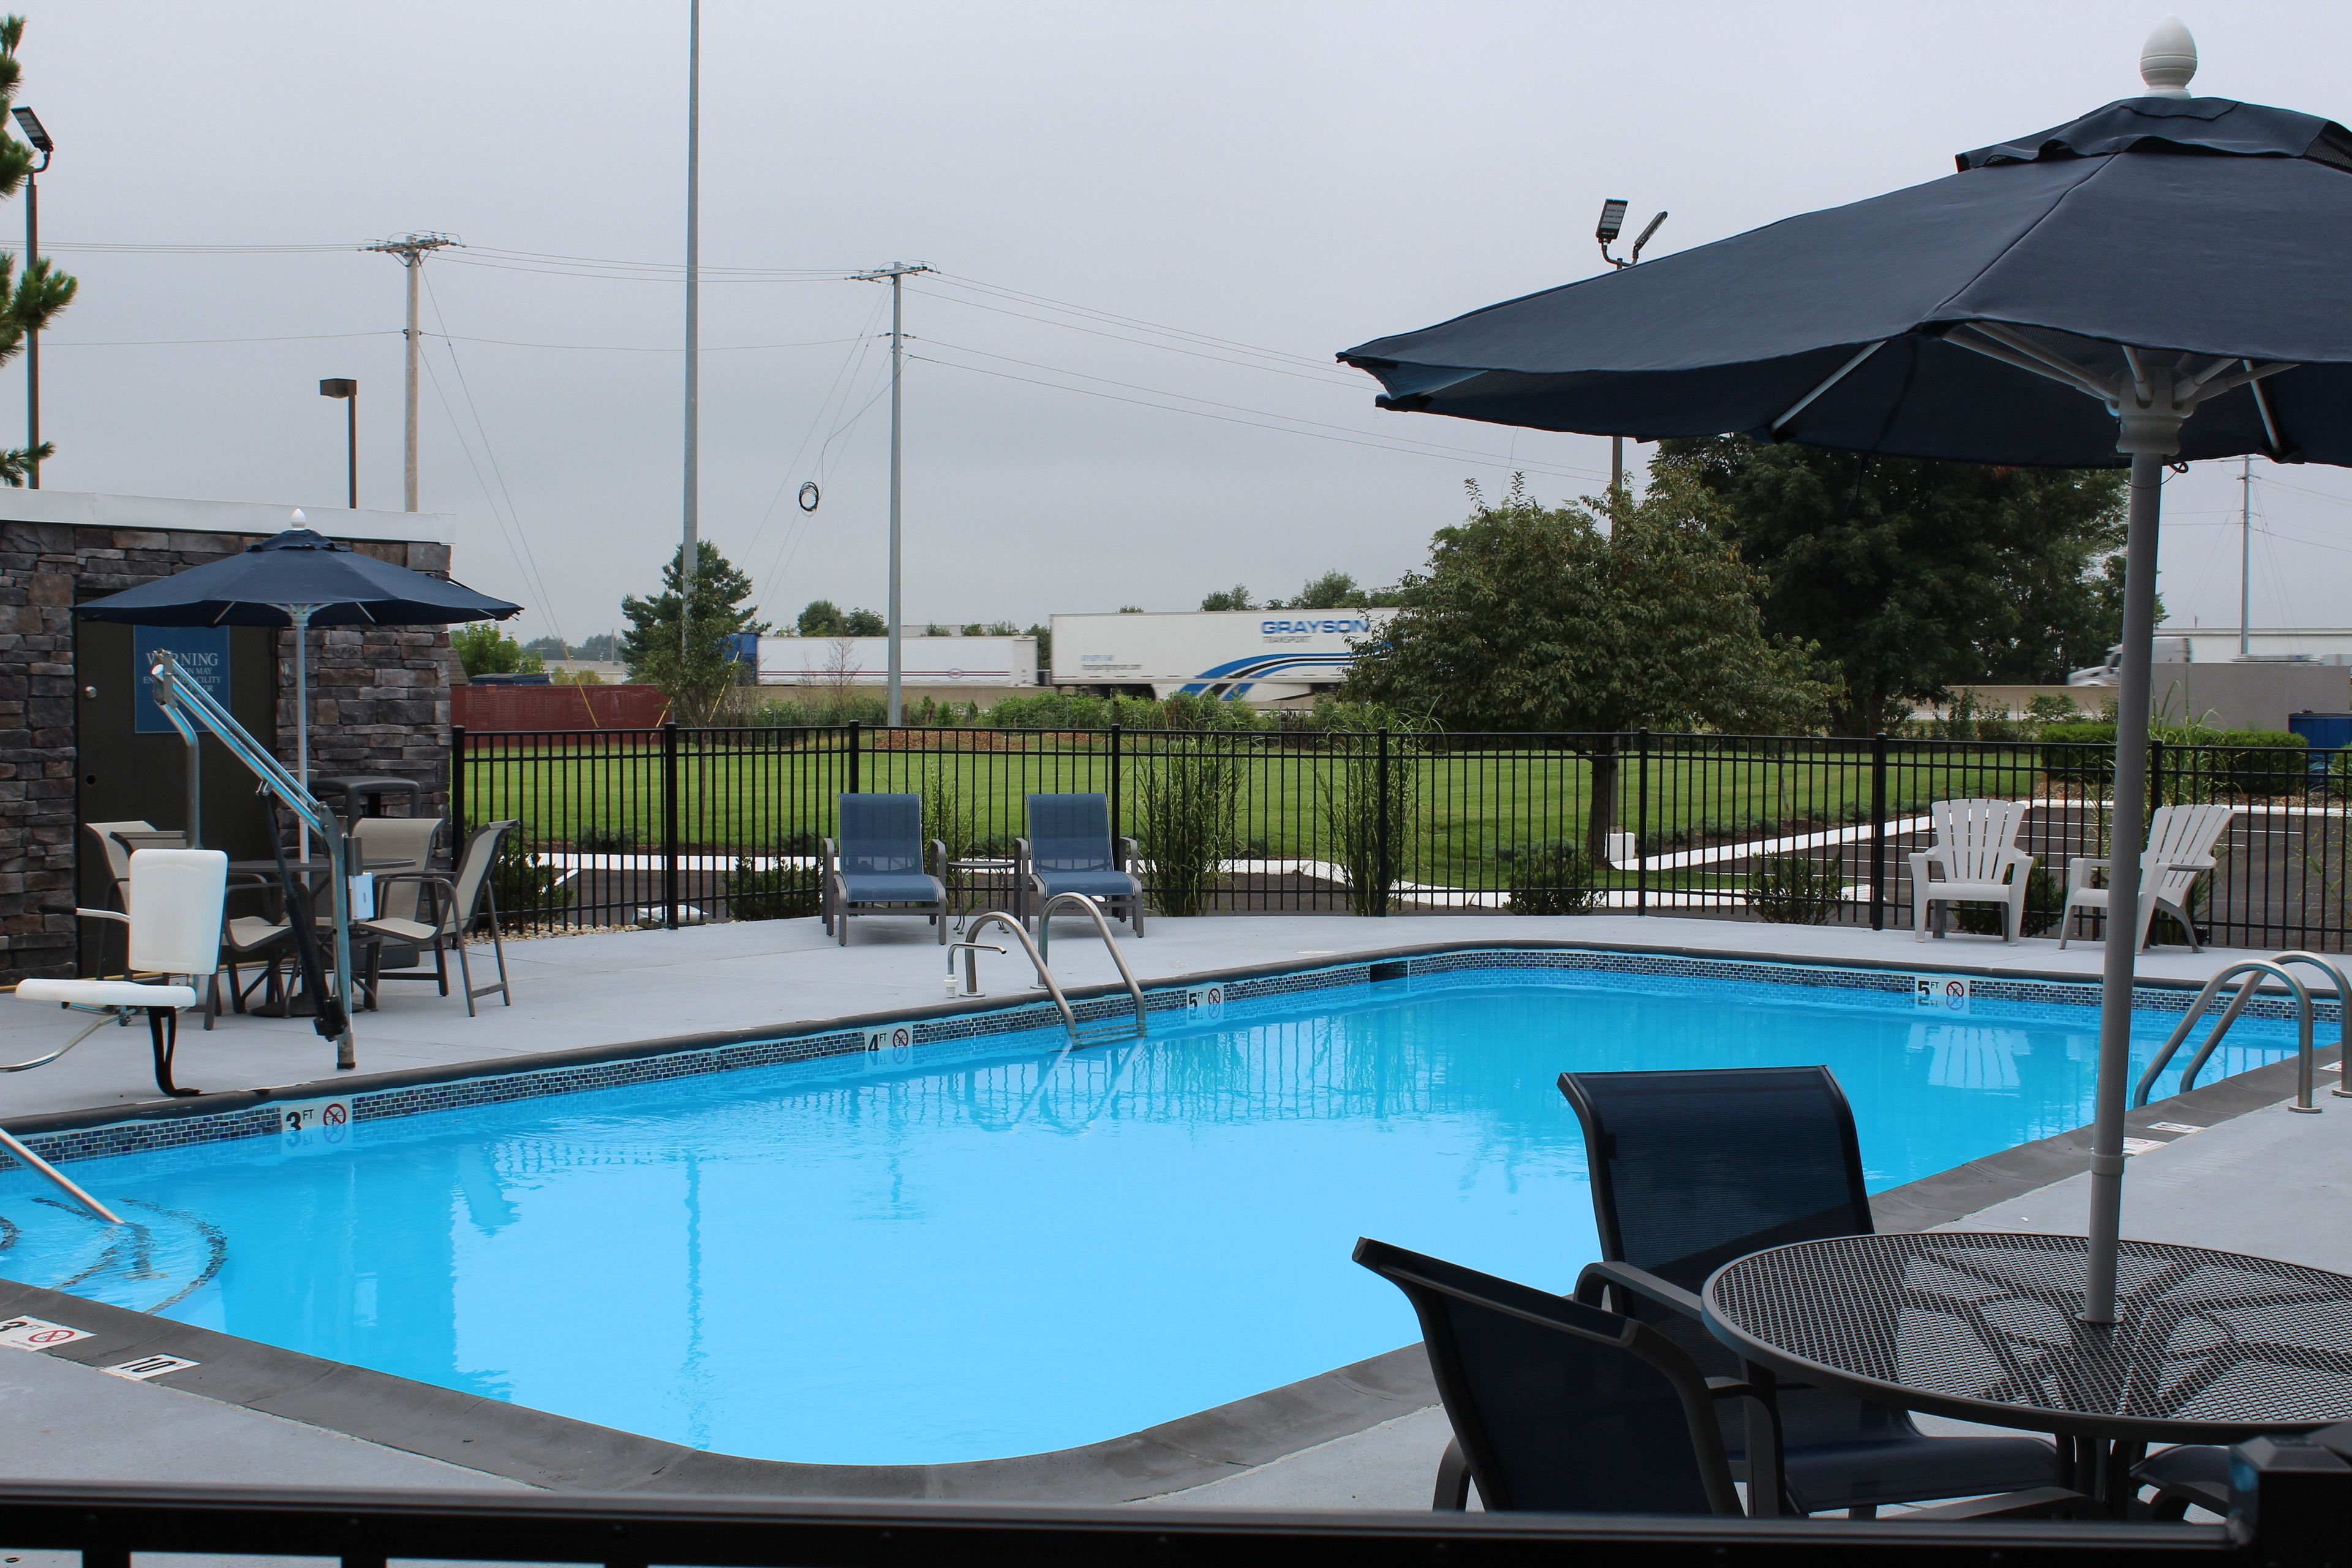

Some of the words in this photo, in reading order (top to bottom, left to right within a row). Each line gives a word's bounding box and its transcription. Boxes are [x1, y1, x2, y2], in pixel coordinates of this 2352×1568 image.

[1262, 620, 1370, 634] GRAYSON
[146, 653, 218, 666] WNING
[1918, 981, 1930, 995] 5
[1189, 993, 1197, 1008] 5
[868, 1034, 880, 1051] 4
[880, 1033, 887, 1042] FT
[286, 1111, 301, 1131] 3
[303, 1109, 314, 1120] FT
[0, 1321, 28, 1332] 3
